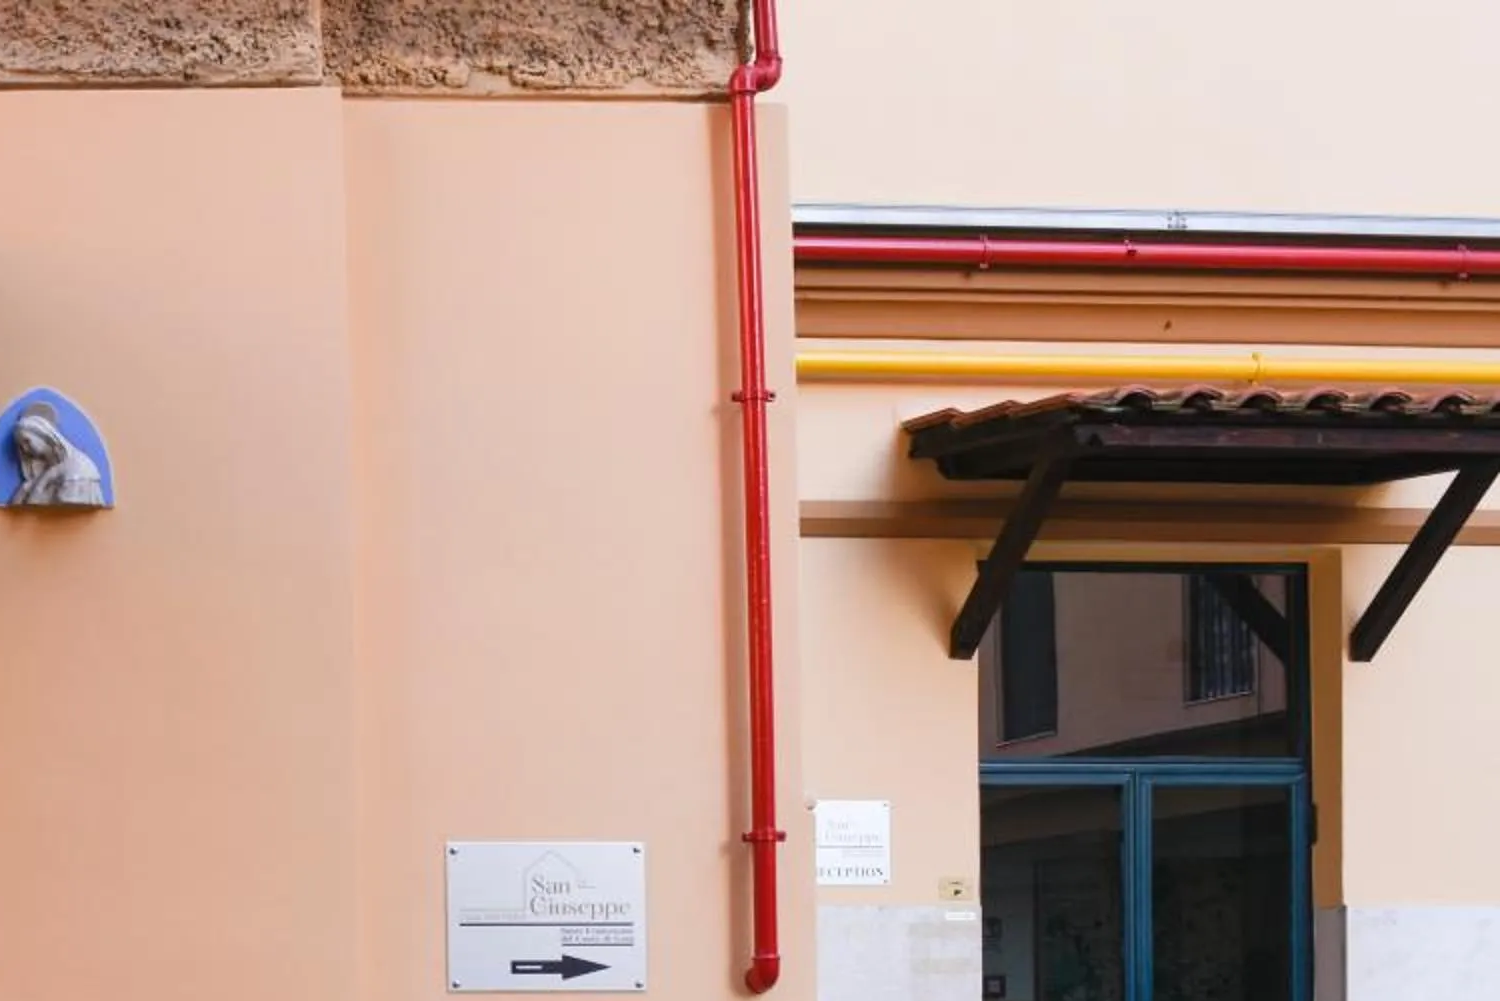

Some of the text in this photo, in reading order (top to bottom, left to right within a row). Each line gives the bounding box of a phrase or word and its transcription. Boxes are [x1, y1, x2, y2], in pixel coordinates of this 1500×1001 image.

[817, 866, 884, 877] ECEPTION
[531, 873, 571, 894] San
[529, 895, 631, 920] Giuseppe
